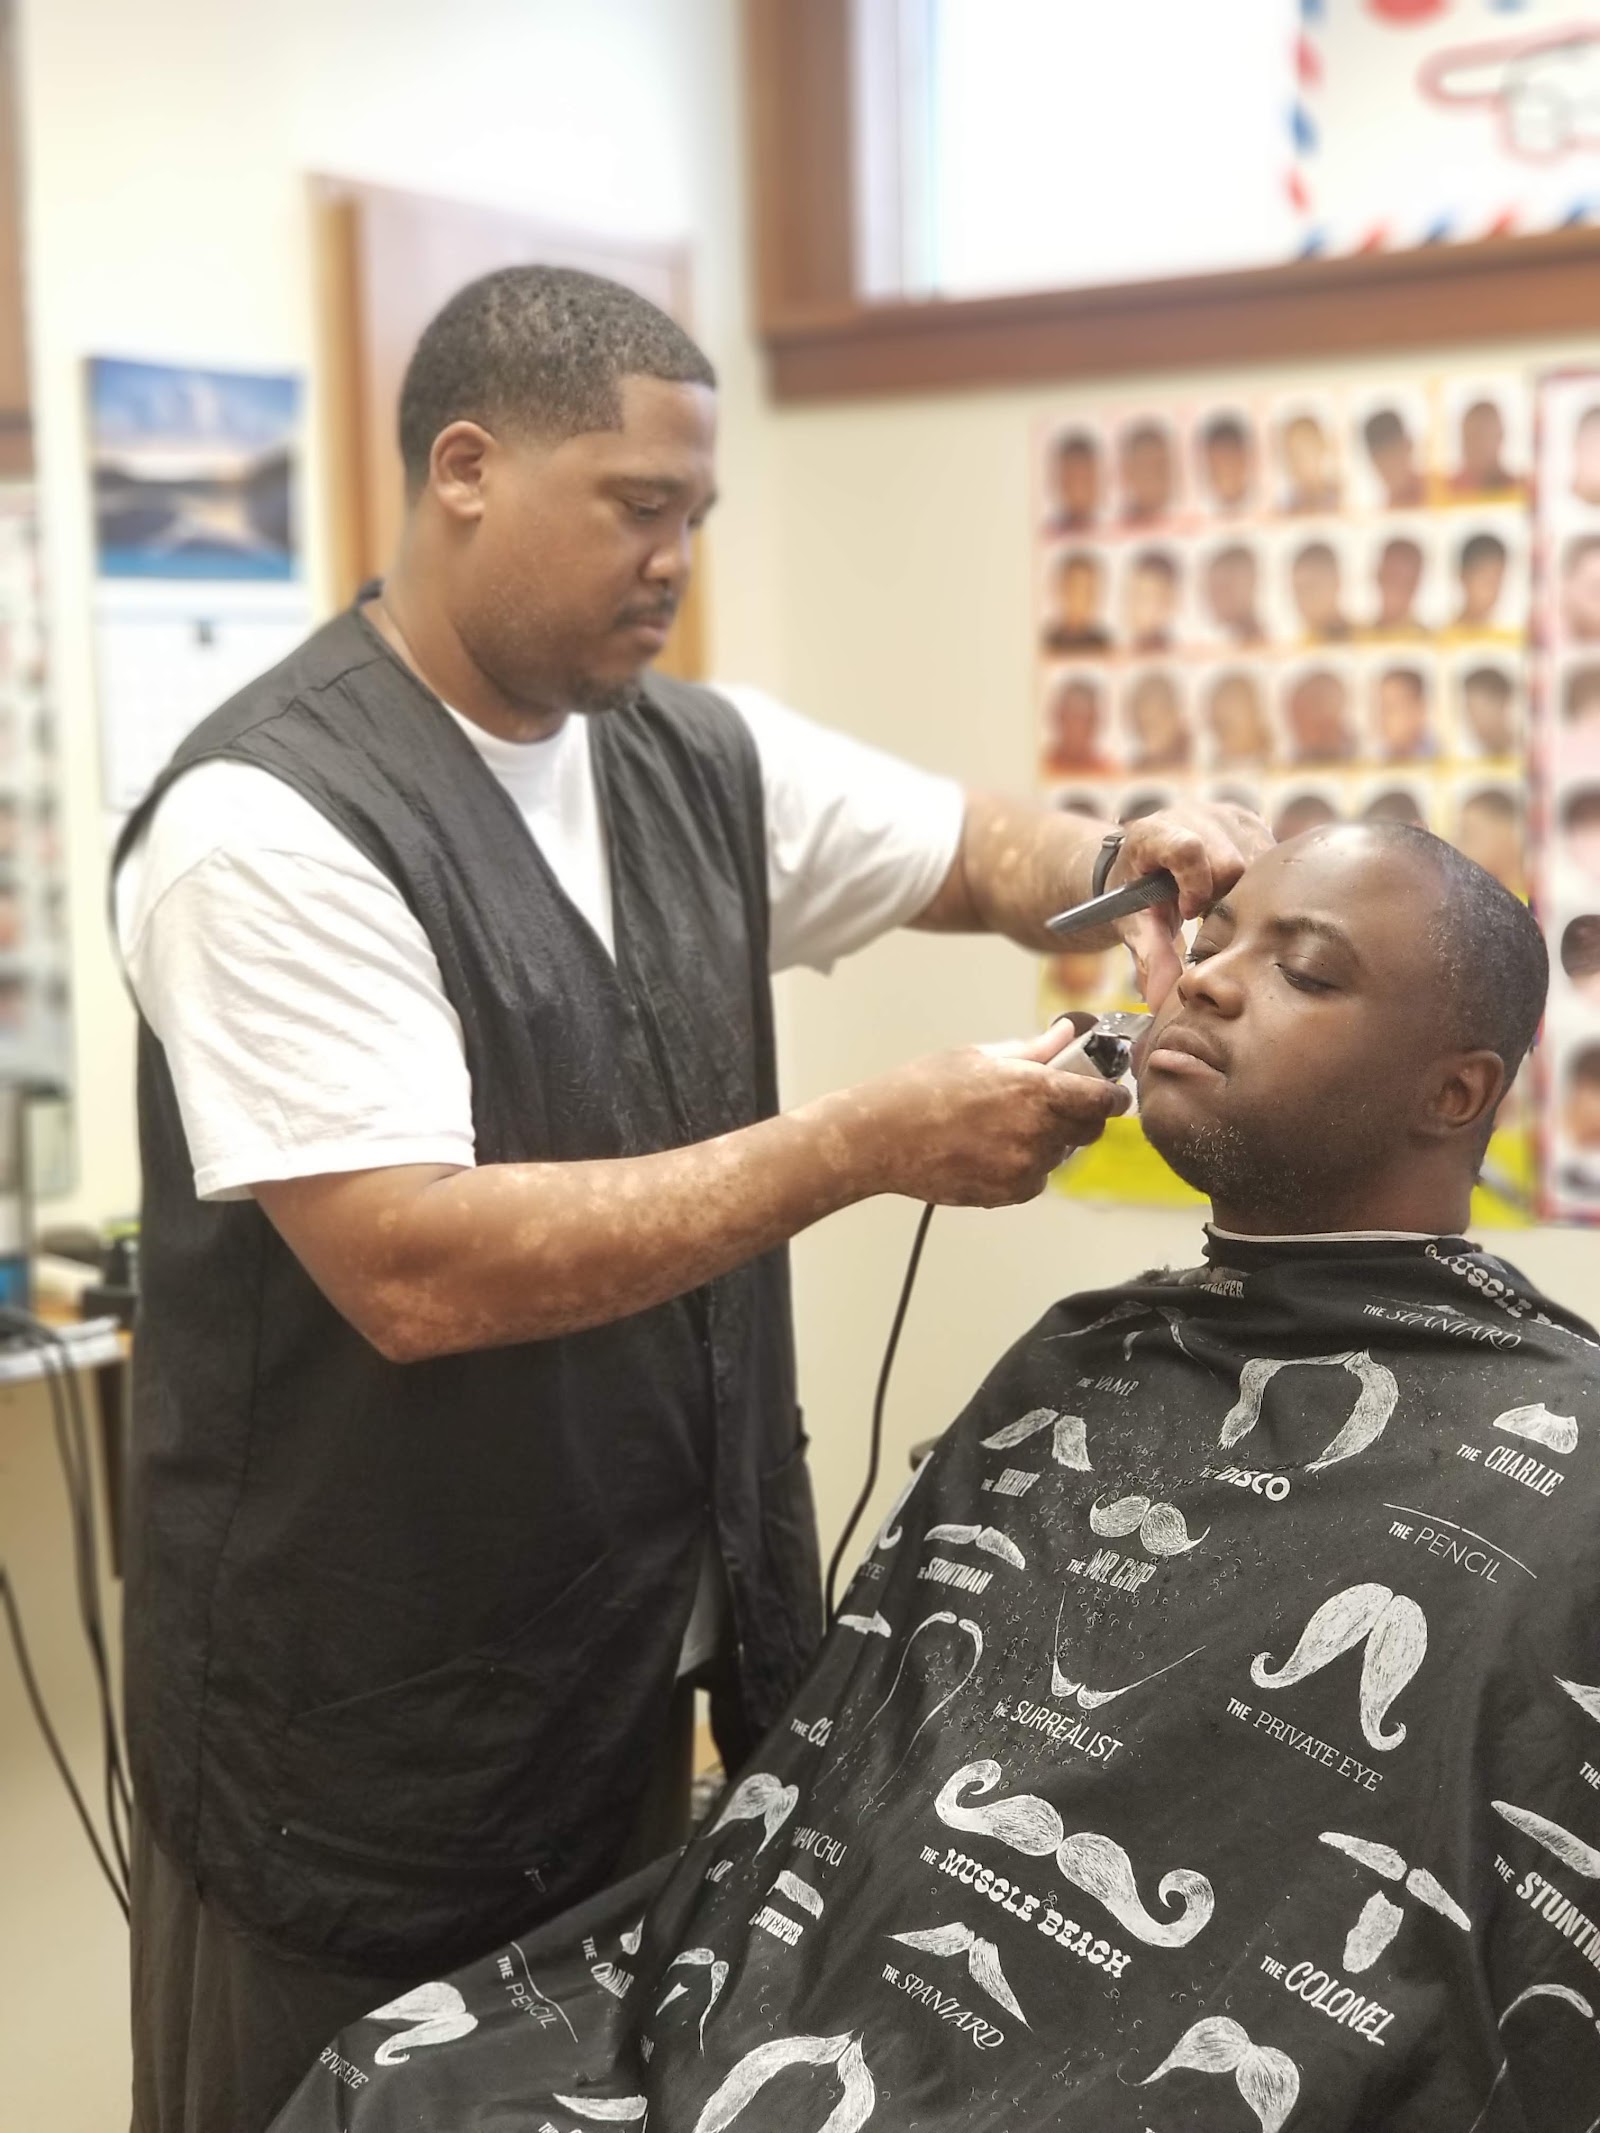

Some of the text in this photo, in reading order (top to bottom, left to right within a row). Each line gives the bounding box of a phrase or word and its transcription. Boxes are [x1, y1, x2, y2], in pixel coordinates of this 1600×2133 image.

[1363, 1304, 1386, 1318] THE
[1386, 1308, 1522, 1351] SPANIARD
[1094, 1375, 1140, 1397] VAMP
[1214, 1466, 1291, 1502] DISCO
[1457, 1443, 1565, 1497] THE CHARLIE
[1066, 1558, 1087, 1575] THE
[1109, 1557, 1157, 1593] CHIP
[1388, 1521, 1500, 1584] THE PENCIL
[790, 1718, 810, 1738] THE
[1010, 1700, 1124, 1762] SURREALIST
[1225, 1697, 1384, 1792] THE PRIVATE EYE
[1493, 1854, 1515, 1883] THE
[918, 1845, 1132, 1978] THE MUSCLE BEACH
[582, 1936, 598, 1960] THE
[496, 1955, 557, 2029] THE PENCIL
[881, 1963, 1005, 2050] THE SPANIARD
[1260, 1955, 1395, 2046] THE COLONEL
